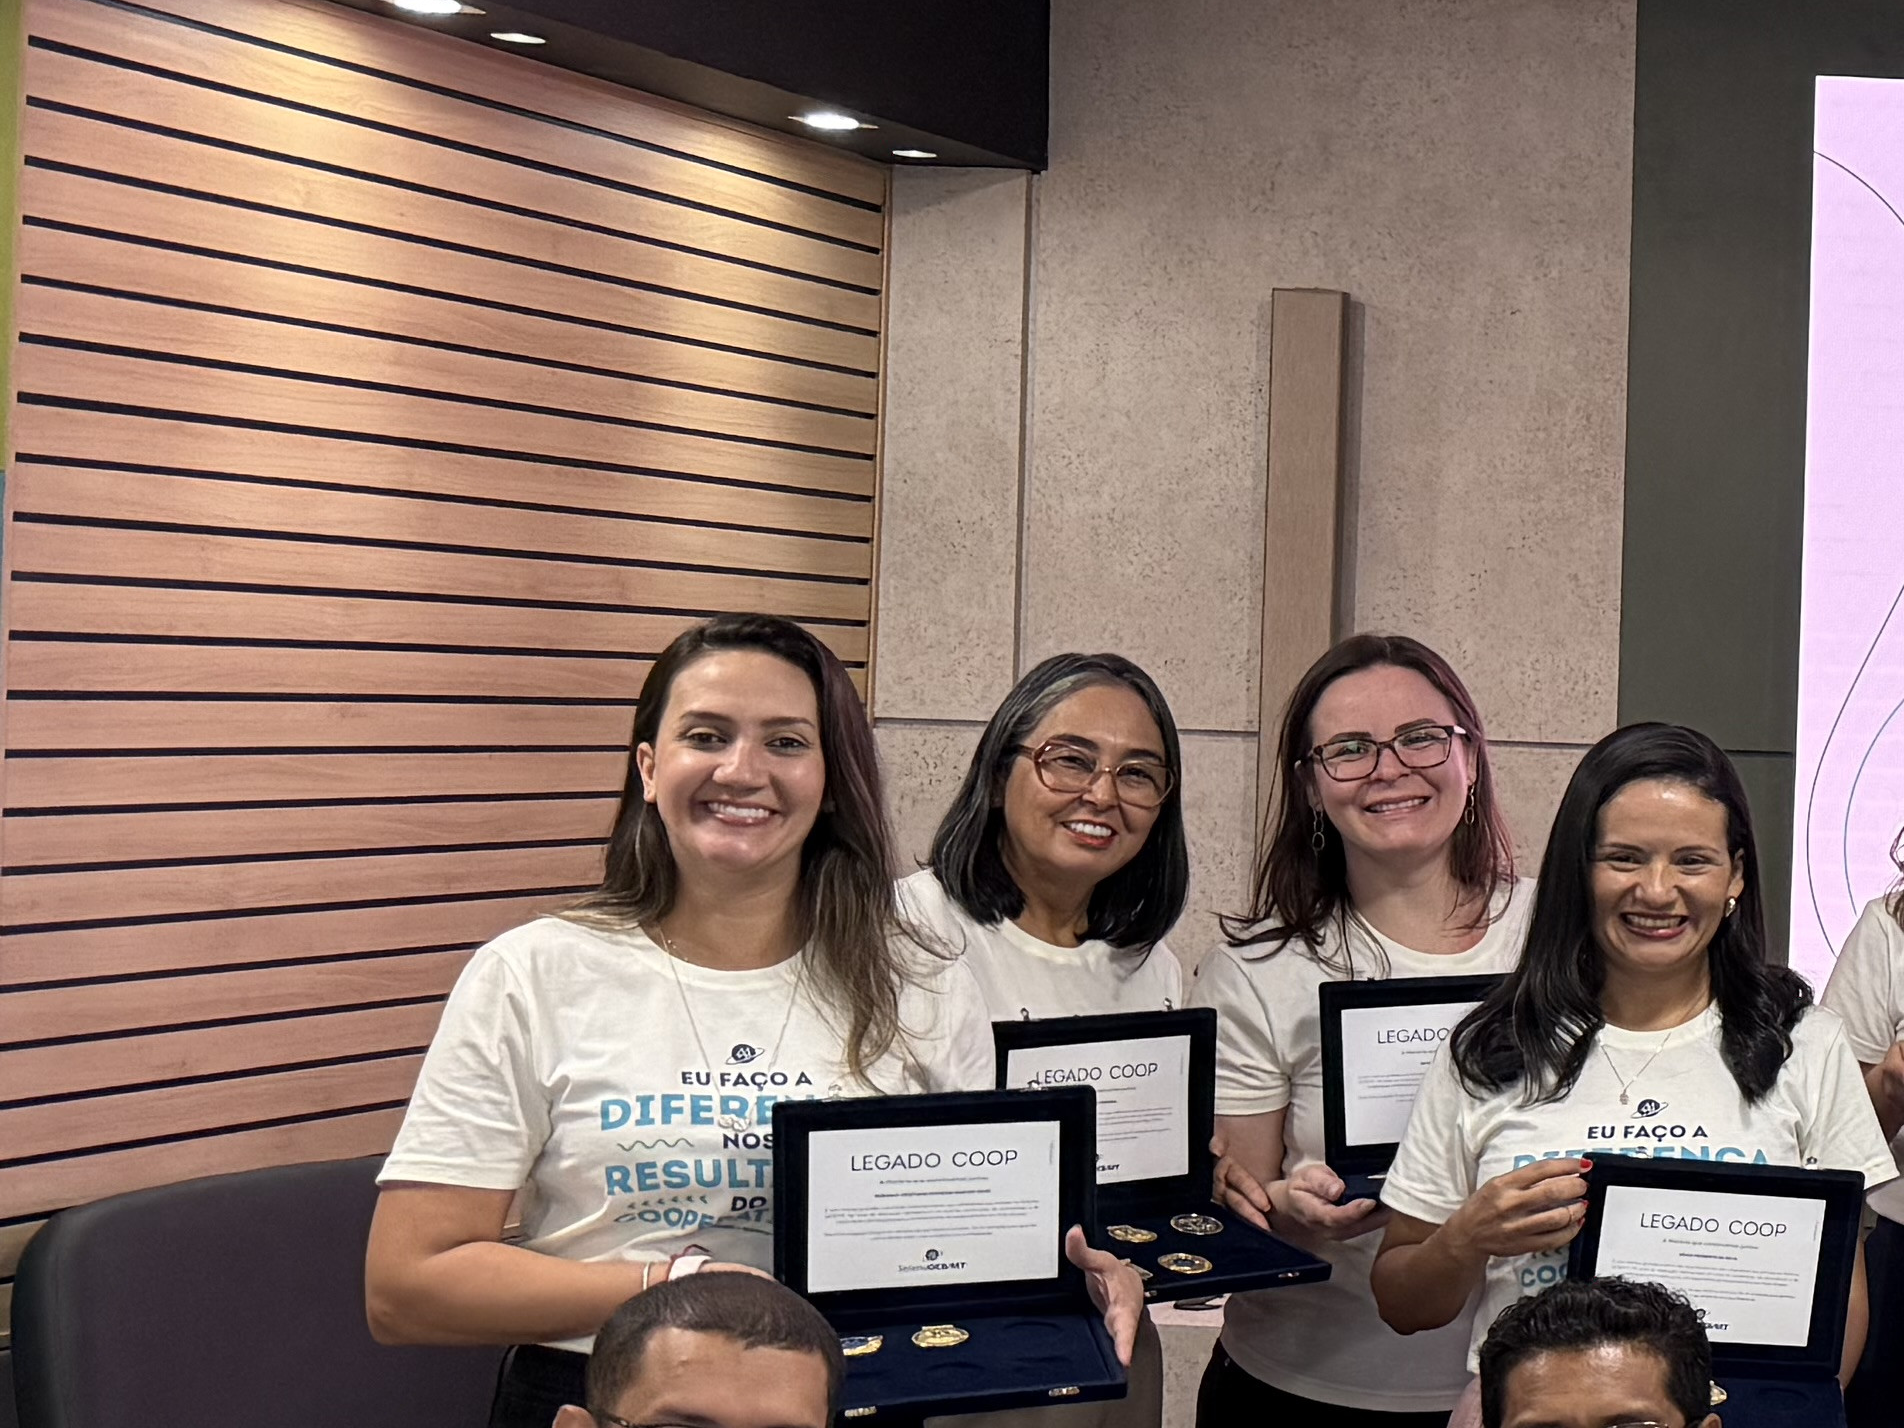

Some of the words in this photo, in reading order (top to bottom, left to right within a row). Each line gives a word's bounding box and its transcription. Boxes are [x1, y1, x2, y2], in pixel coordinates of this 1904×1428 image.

[681, 1071, 710, 1086] EU
[719, 1072, 788, 1092] FAÇO
[795, 1072, 813, 1086] A
[1110, 1063, 1158, 1080] COOP
[1587, 1126, 1615, 1139] EU
[1623, 1125, 1686, 1142] FAÇO
[1692, 1126, 1708, 1138] A
[851, 1153, 940, 1171] LEGADO
[952, 1150, 1017, 1167] COOP
[605, 1158, 773, 1196] RESULT
[1641, 1213, 1719, 1232] LEGADO
[1729, 1220, 1787, 1237] COOP
